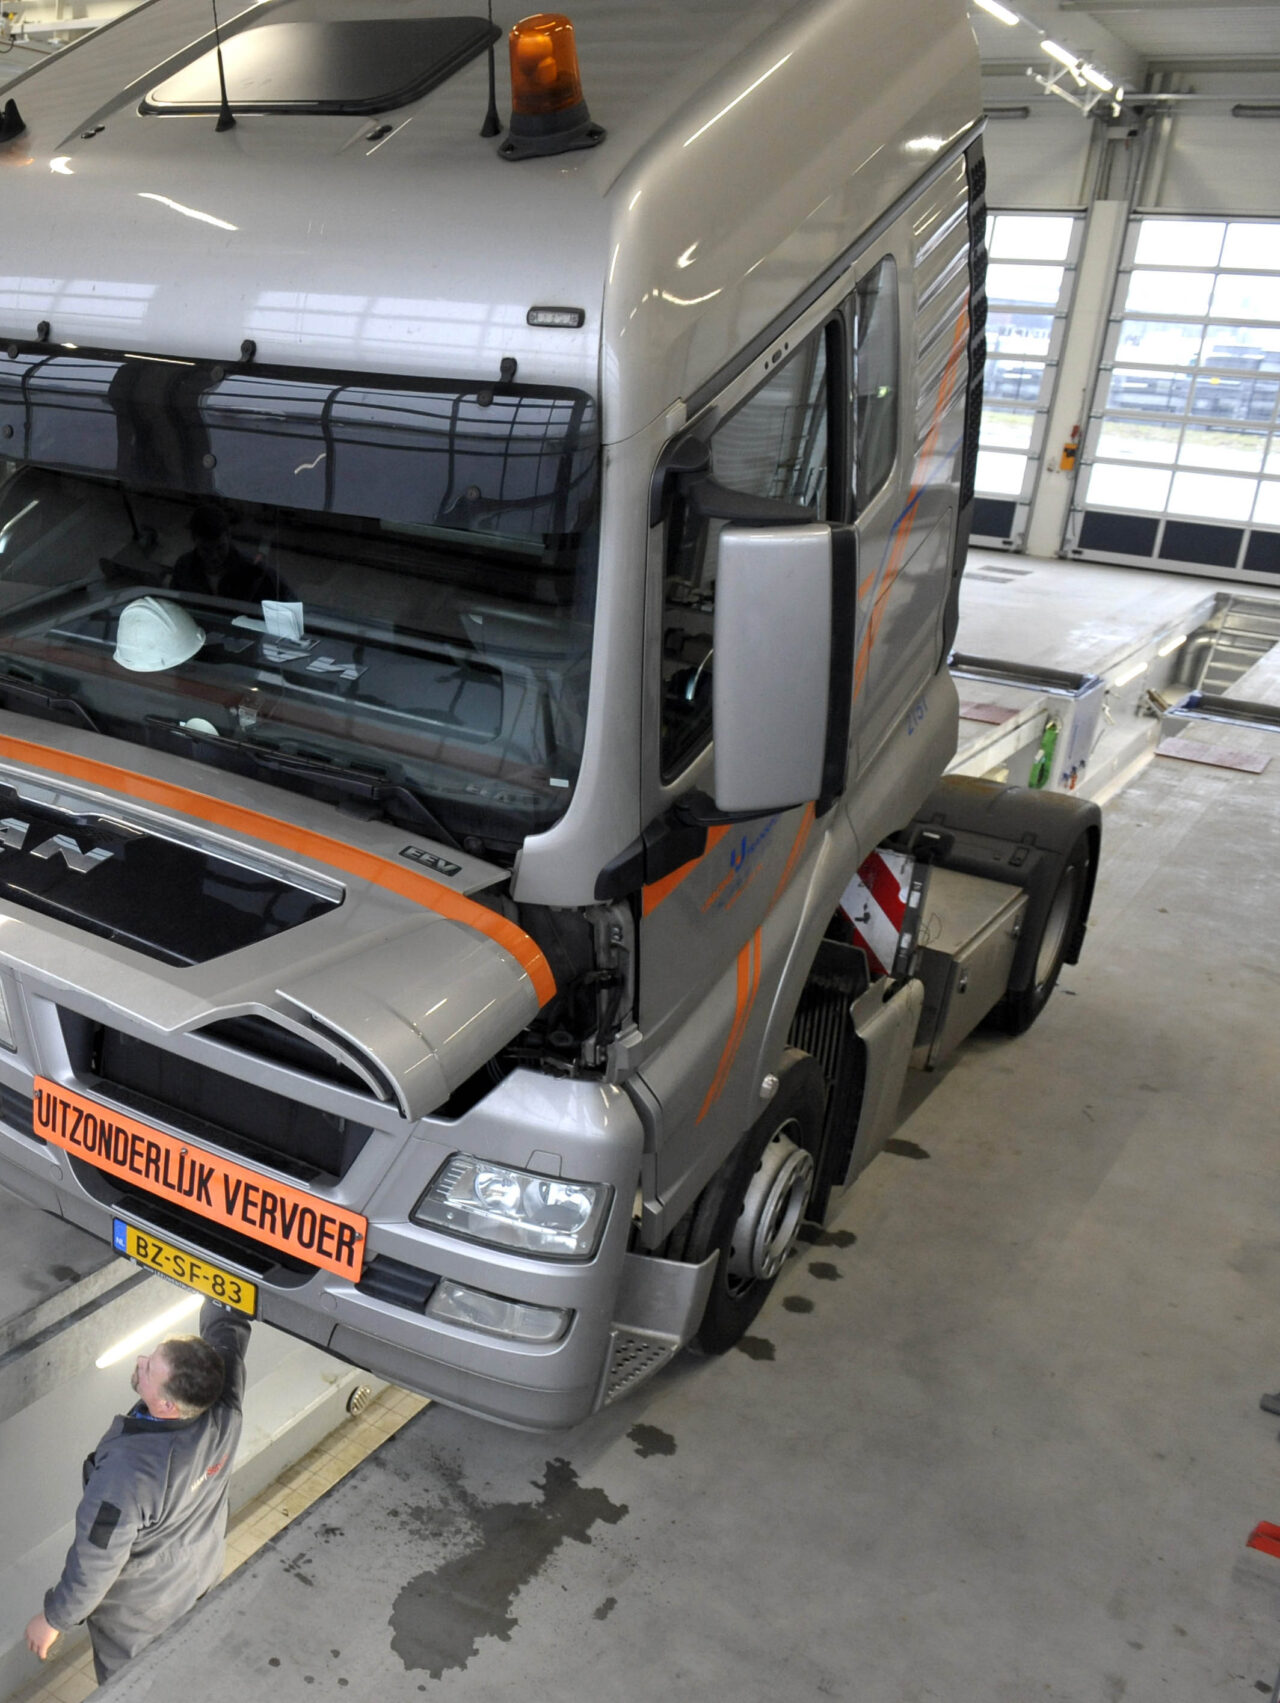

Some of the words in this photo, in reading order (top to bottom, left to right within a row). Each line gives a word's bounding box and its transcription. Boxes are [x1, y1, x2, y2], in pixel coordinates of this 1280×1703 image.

[404, 846, 458, 873] EEV
[37, 1088, 215, 1208] UITZONDERLIJK
[223, 1173, 358, 1268] VERVOER
[115, 1236, 126, 1247] NL
[136, 1234, 242, 1304] BZ-SF-83
